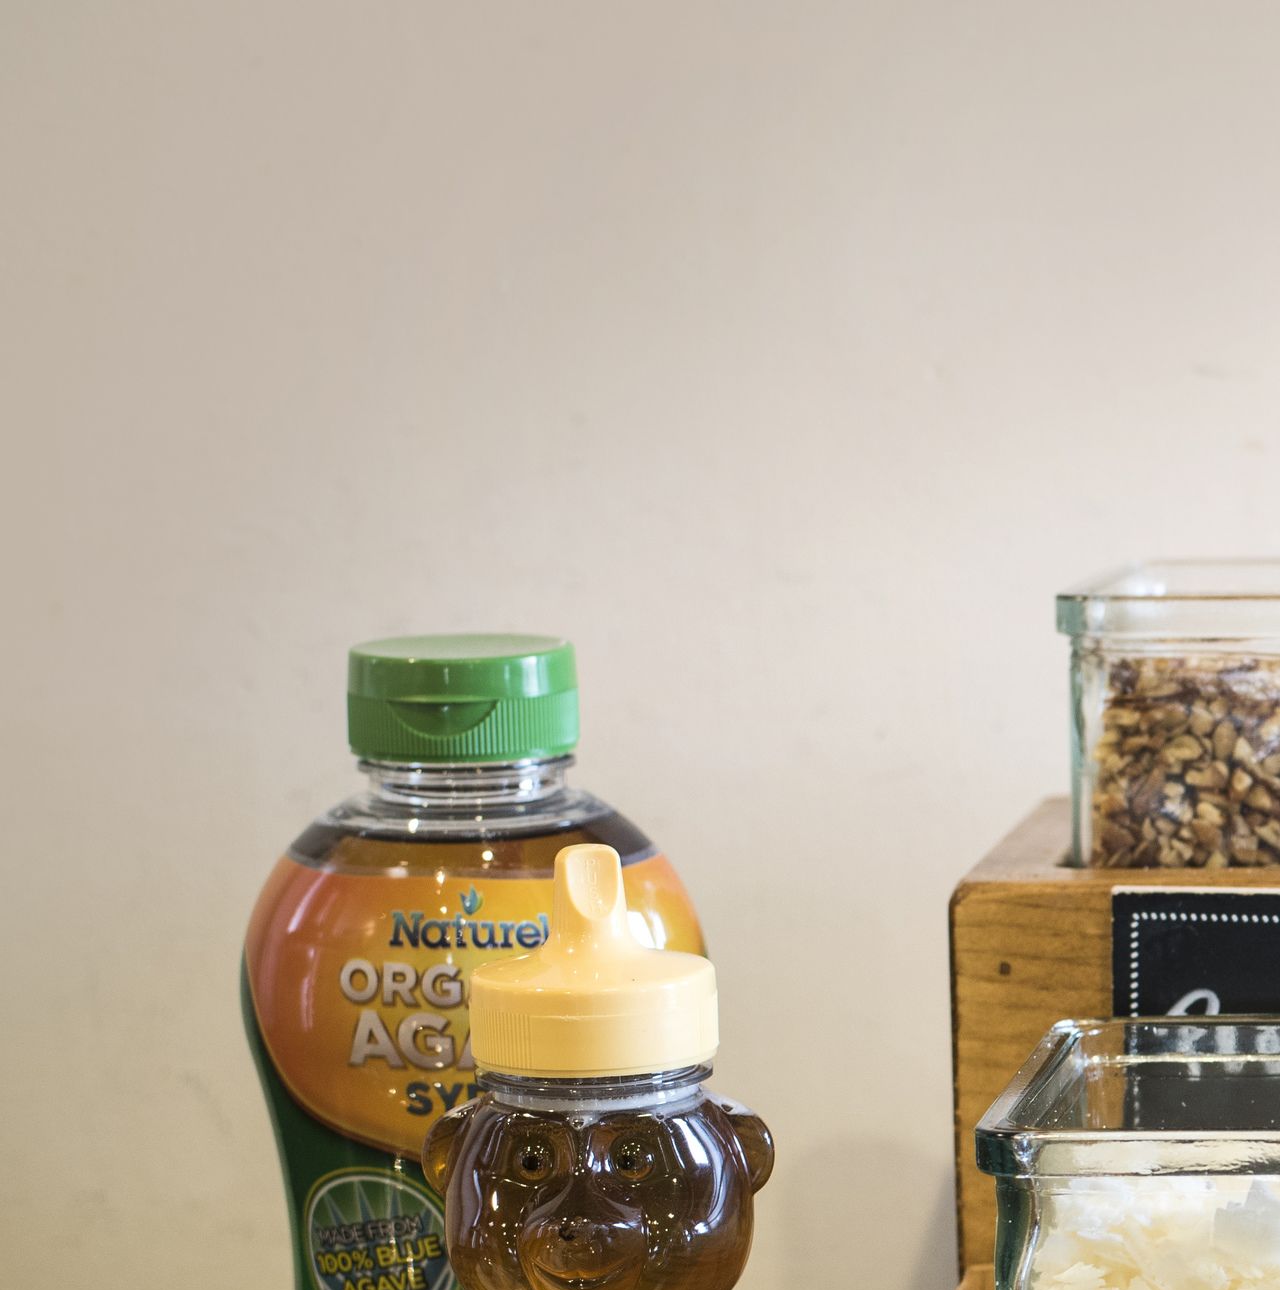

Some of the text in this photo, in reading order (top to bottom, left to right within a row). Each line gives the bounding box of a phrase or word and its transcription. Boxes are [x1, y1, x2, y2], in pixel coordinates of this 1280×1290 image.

[340, 958, 470, 1009] ORG
[318, 1215, 424, 1245] MADE FROM
[317, 1235, 441, 1275] 100% BLUE
